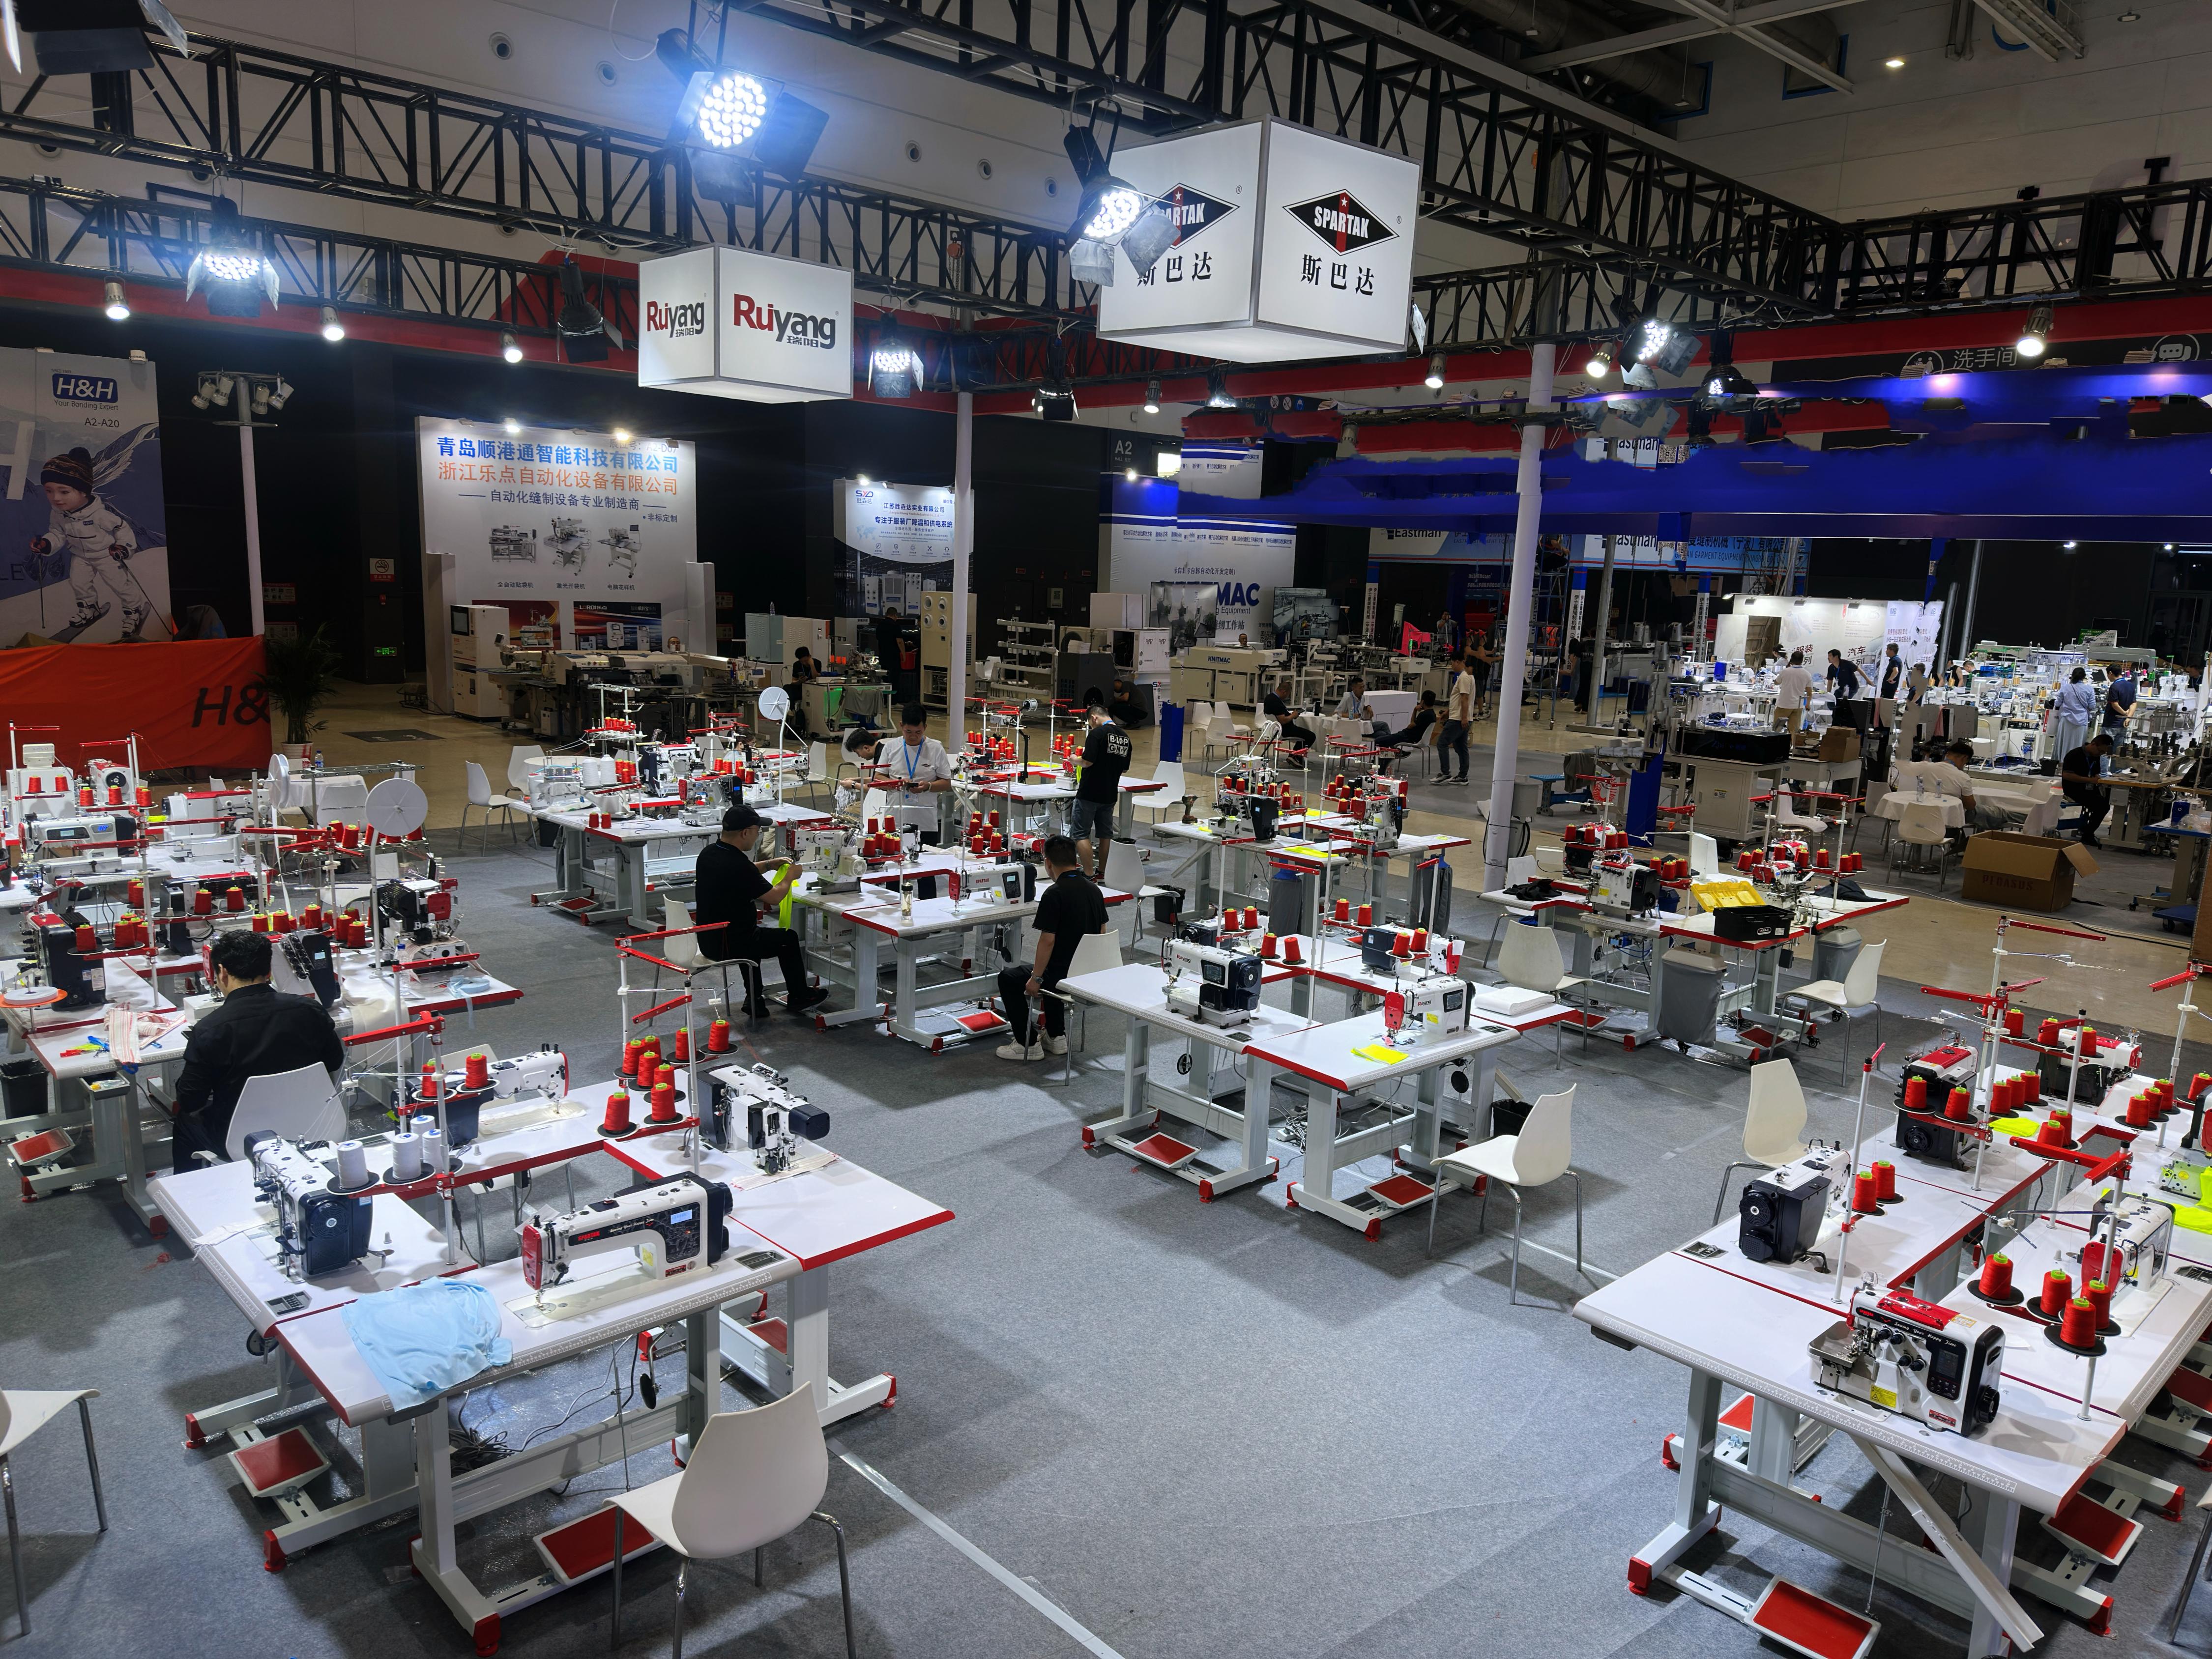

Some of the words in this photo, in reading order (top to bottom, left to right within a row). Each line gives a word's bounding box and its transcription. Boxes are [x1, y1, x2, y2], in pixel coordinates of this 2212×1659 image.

[1161, 202, 1205, 227] ARTAK
[1314, 206, 1369, 239] SPARTAK
[1301, 254, 1374, 296] 斯巴达
[675, 328, 694, 337] 瑞阳
[786, 335, 819, 348] 瑞阳
[1952, 348, 2016, 369] 洗手间
[57, 377, 114, 400] H&H
[71, 401, 97, 410] Bonding
[85, 418, 119, 428] A2-A20
[1115, 440, 1132, 455] A2
[1617, 439, 1658, 451] astman
[437, 436, 678, 474] 青岛顺港通智能科技有限公司
[438, 461, 677, 495] 浙江乐点自动化设备有限公司
[491, 489, 640, 510] 自动化缝制设备专业制造商
[647, 513, 677, 523] 非标定制
[875, 516, 953, 528] 专注于服装厂降温和供电系统
[1395, 529, 1441, 538] Eastman
[1616, 535, 1658, 551] astman
[1694, 551, 1717, 559] GARMENT
[1221, 607, 1251, 615] Equipment
[1847, 646, 1866, 657] 汽车
[1894, 1322, 1910, 1331] Sewing
[1927, 1333, 1942, 1342] Happy
